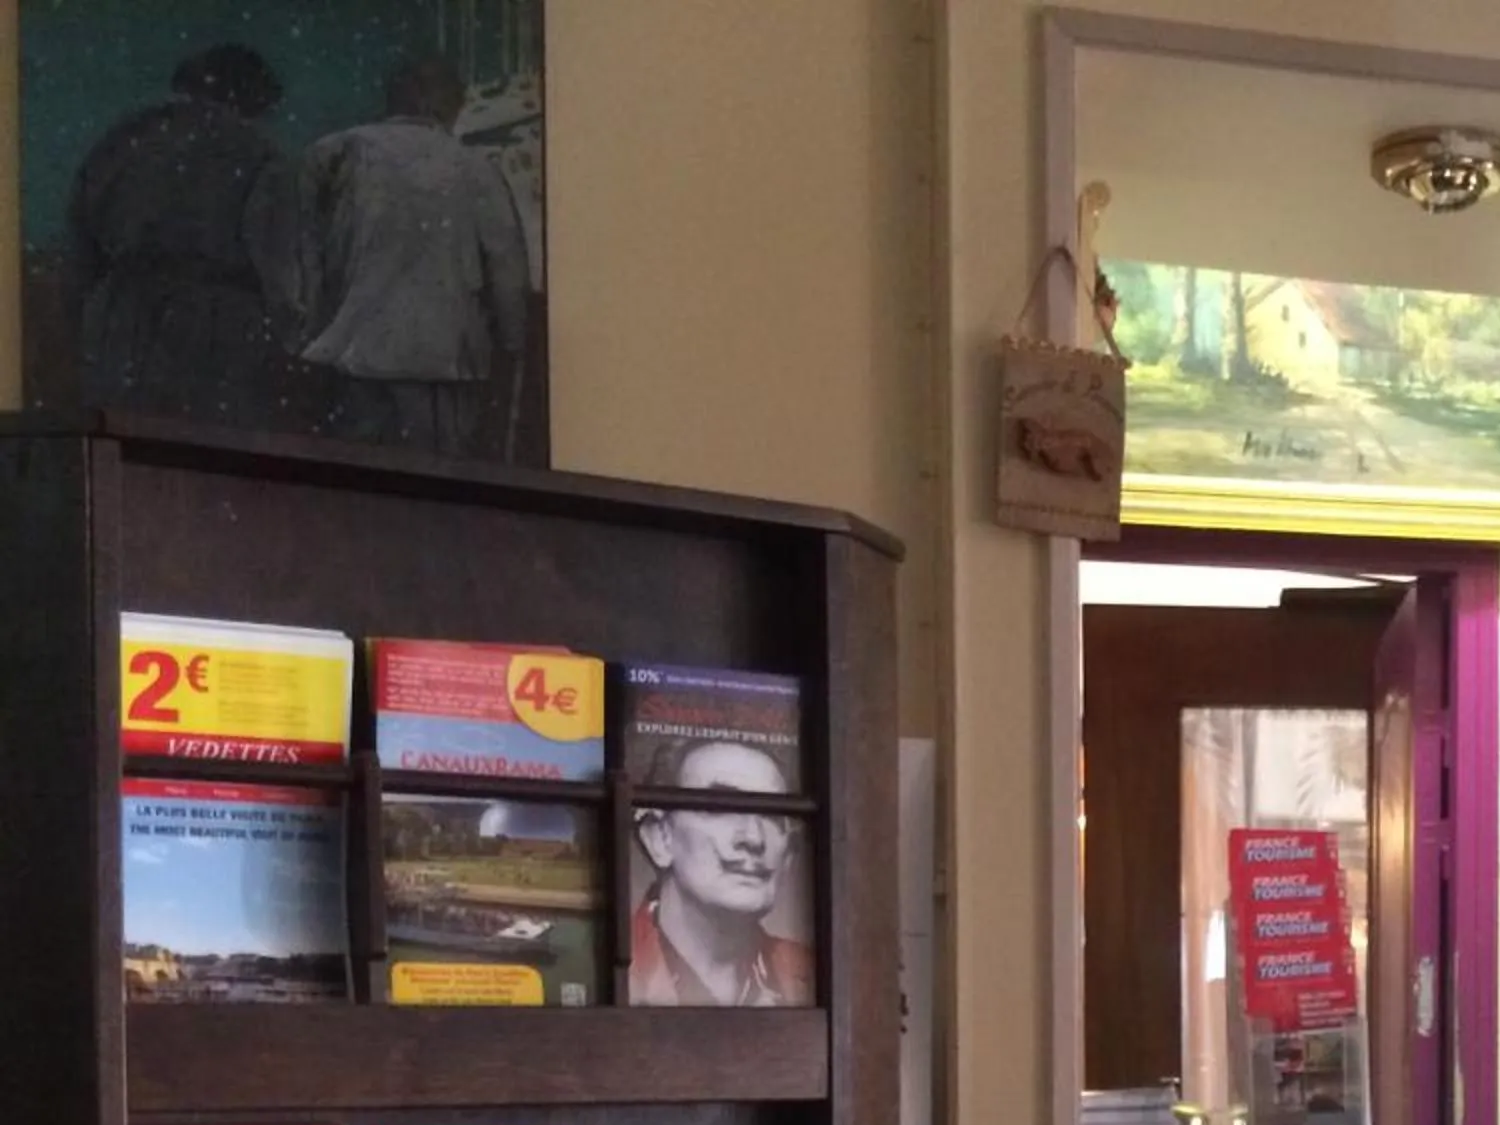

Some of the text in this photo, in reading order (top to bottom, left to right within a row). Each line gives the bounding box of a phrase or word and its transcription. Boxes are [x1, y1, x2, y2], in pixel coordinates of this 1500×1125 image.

[127, 650, 209, 723] 2€
[514, 667, 578, 715] 4€
[166, 737, 301, 765] VEDETTES
